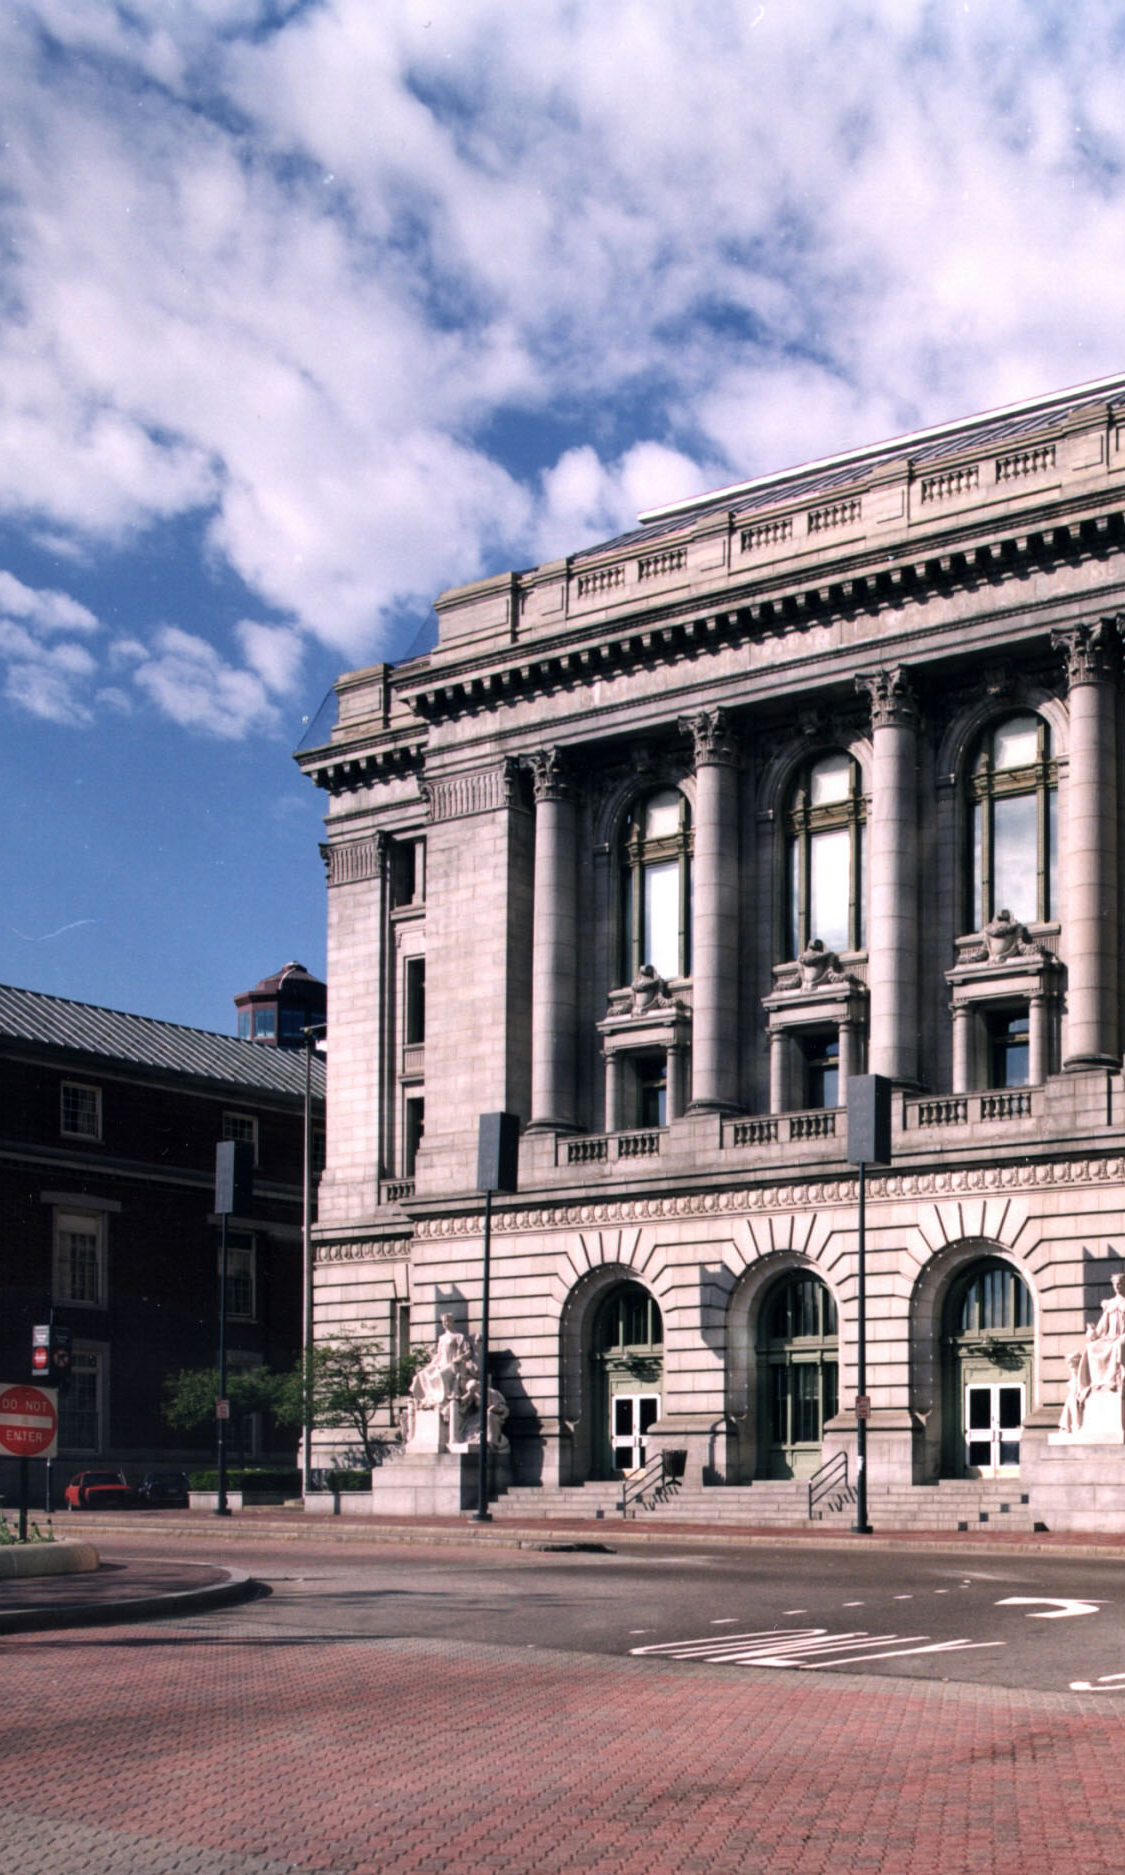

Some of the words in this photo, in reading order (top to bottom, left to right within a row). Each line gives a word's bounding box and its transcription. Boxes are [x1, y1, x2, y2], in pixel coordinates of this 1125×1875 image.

[2, 1398, 18, 1410] DO
[26, 1400, 48, 1412] NOT
[5, 1429, 43, 1443] ENTER
[629, 1629, 1006, 1669] ONLY
